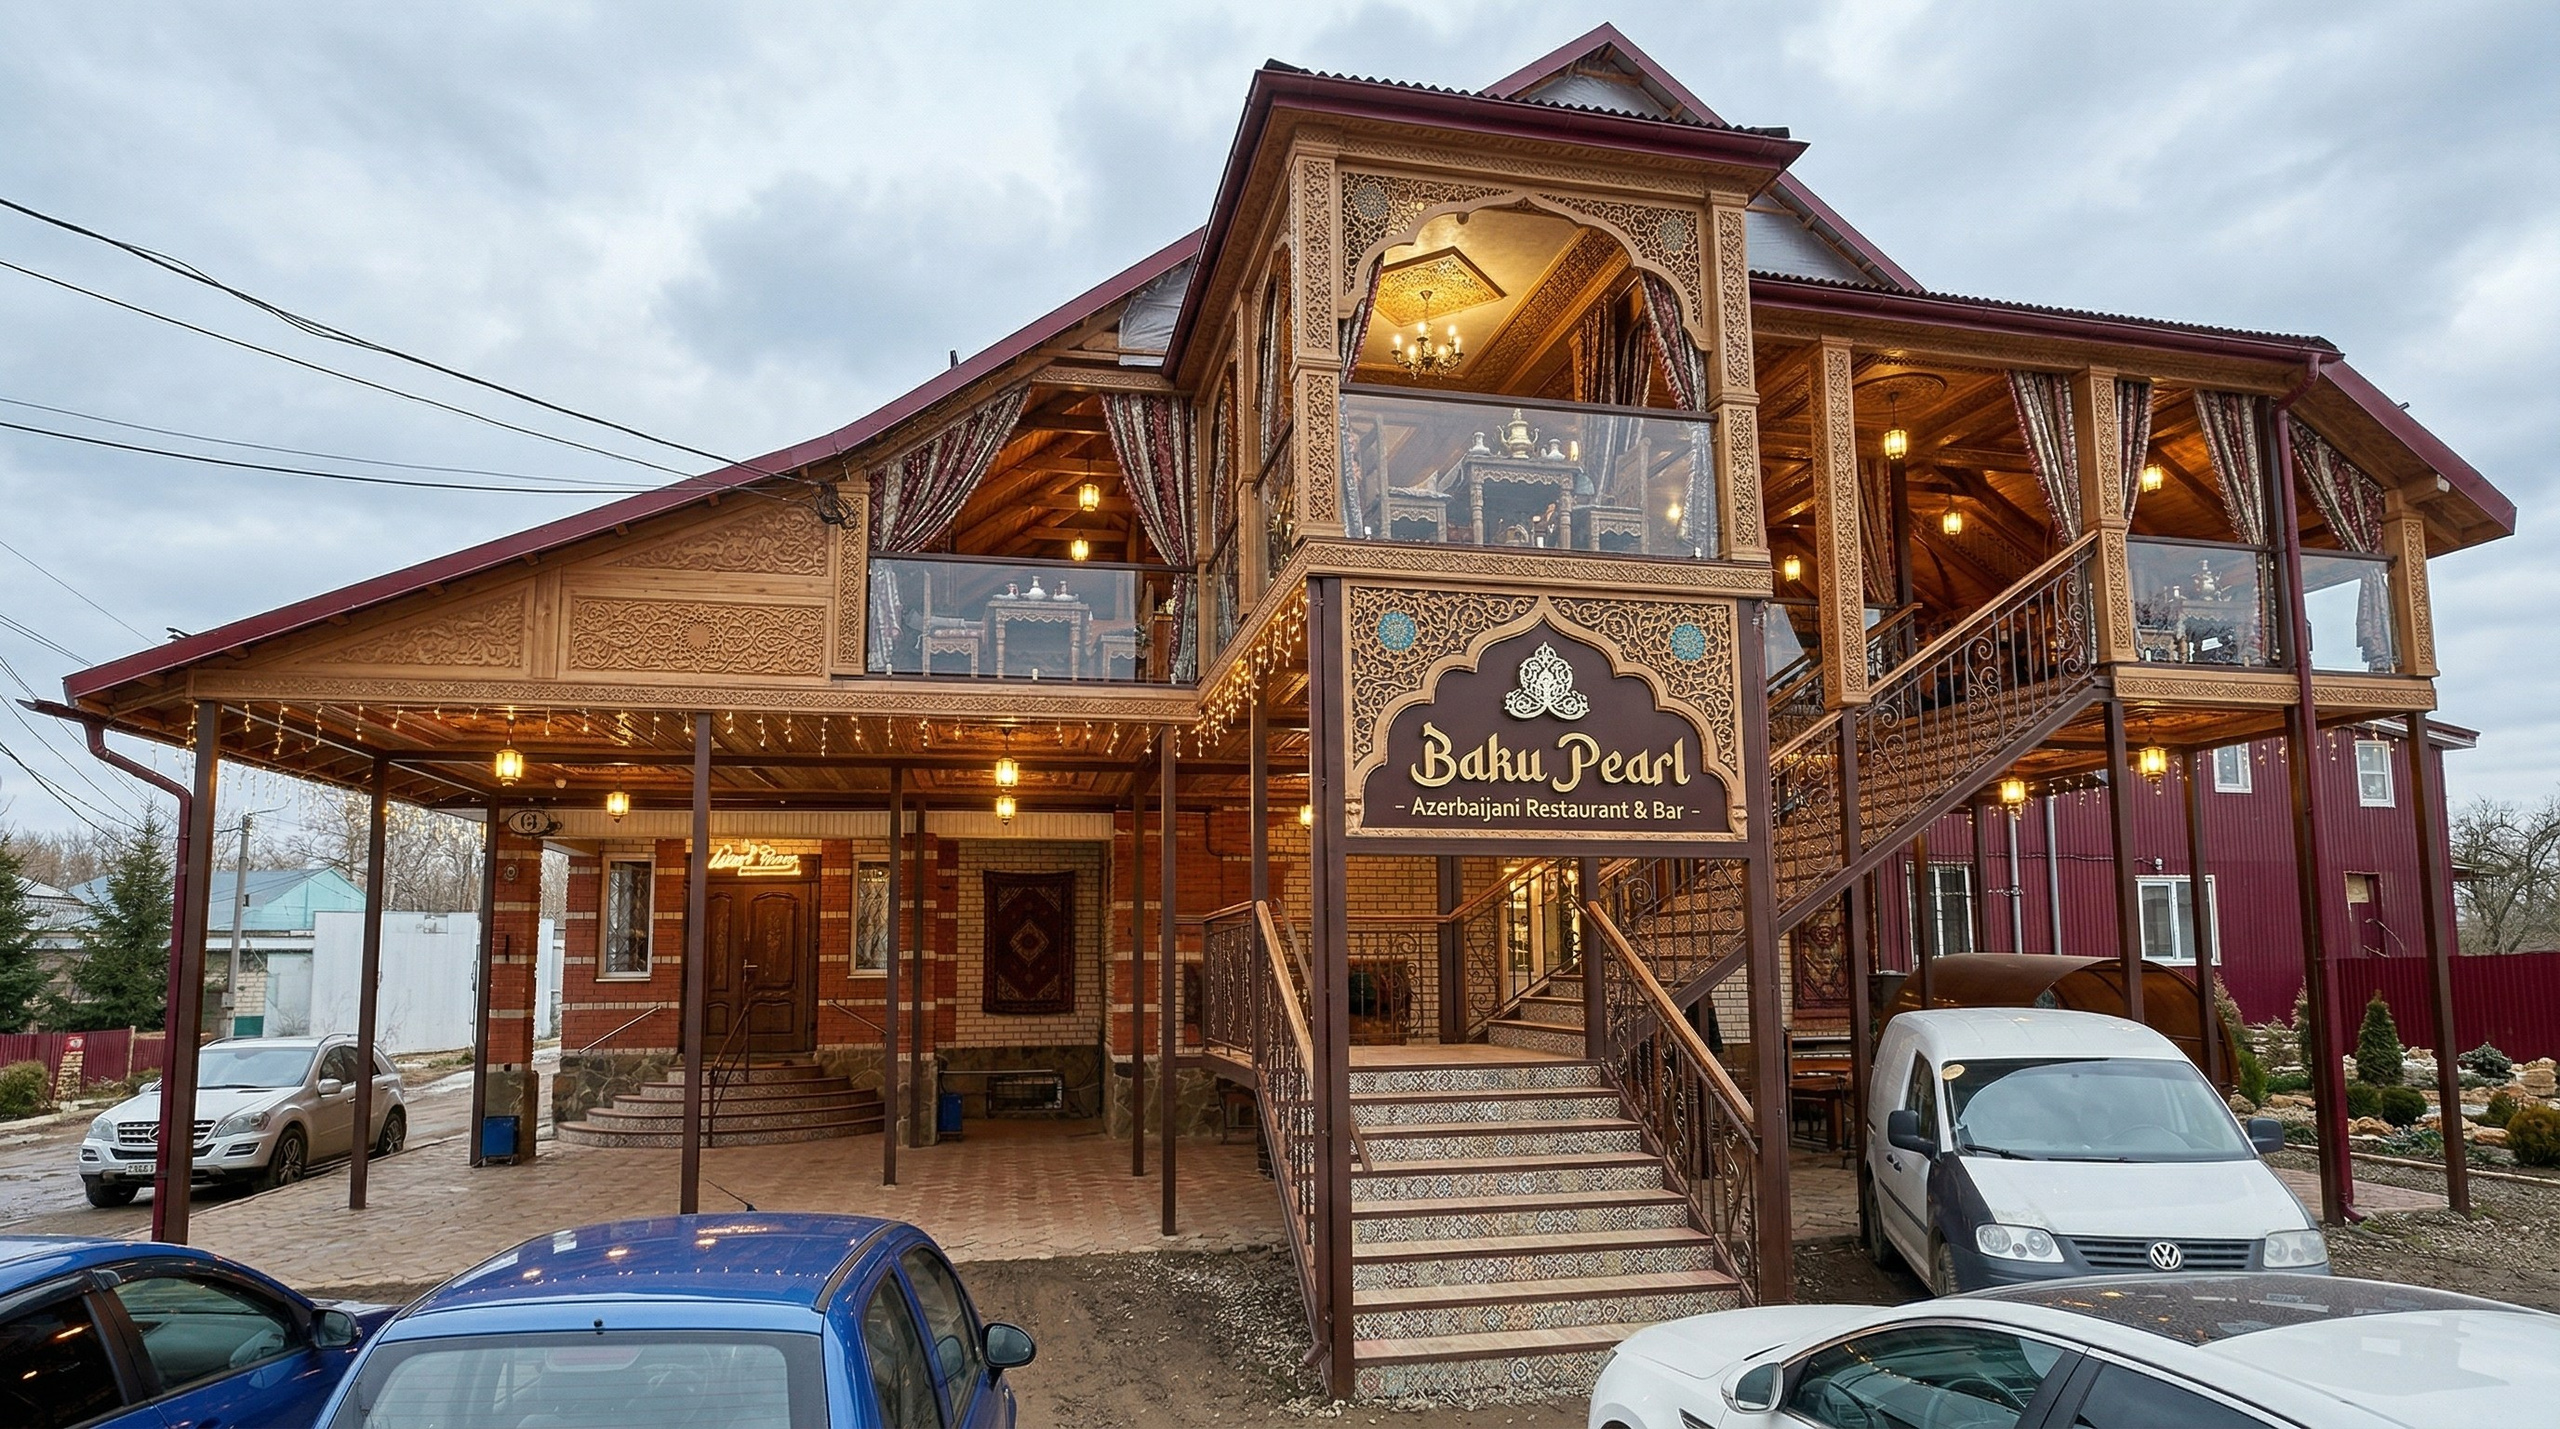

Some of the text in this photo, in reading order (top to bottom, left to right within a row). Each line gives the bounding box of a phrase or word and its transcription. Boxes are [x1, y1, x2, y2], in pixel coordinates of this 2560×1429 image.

[1410, 721, 1692, 794] Baku Pearl
[1411, 796, 1685, 822] Azerbaijani Restaurant & Bar
